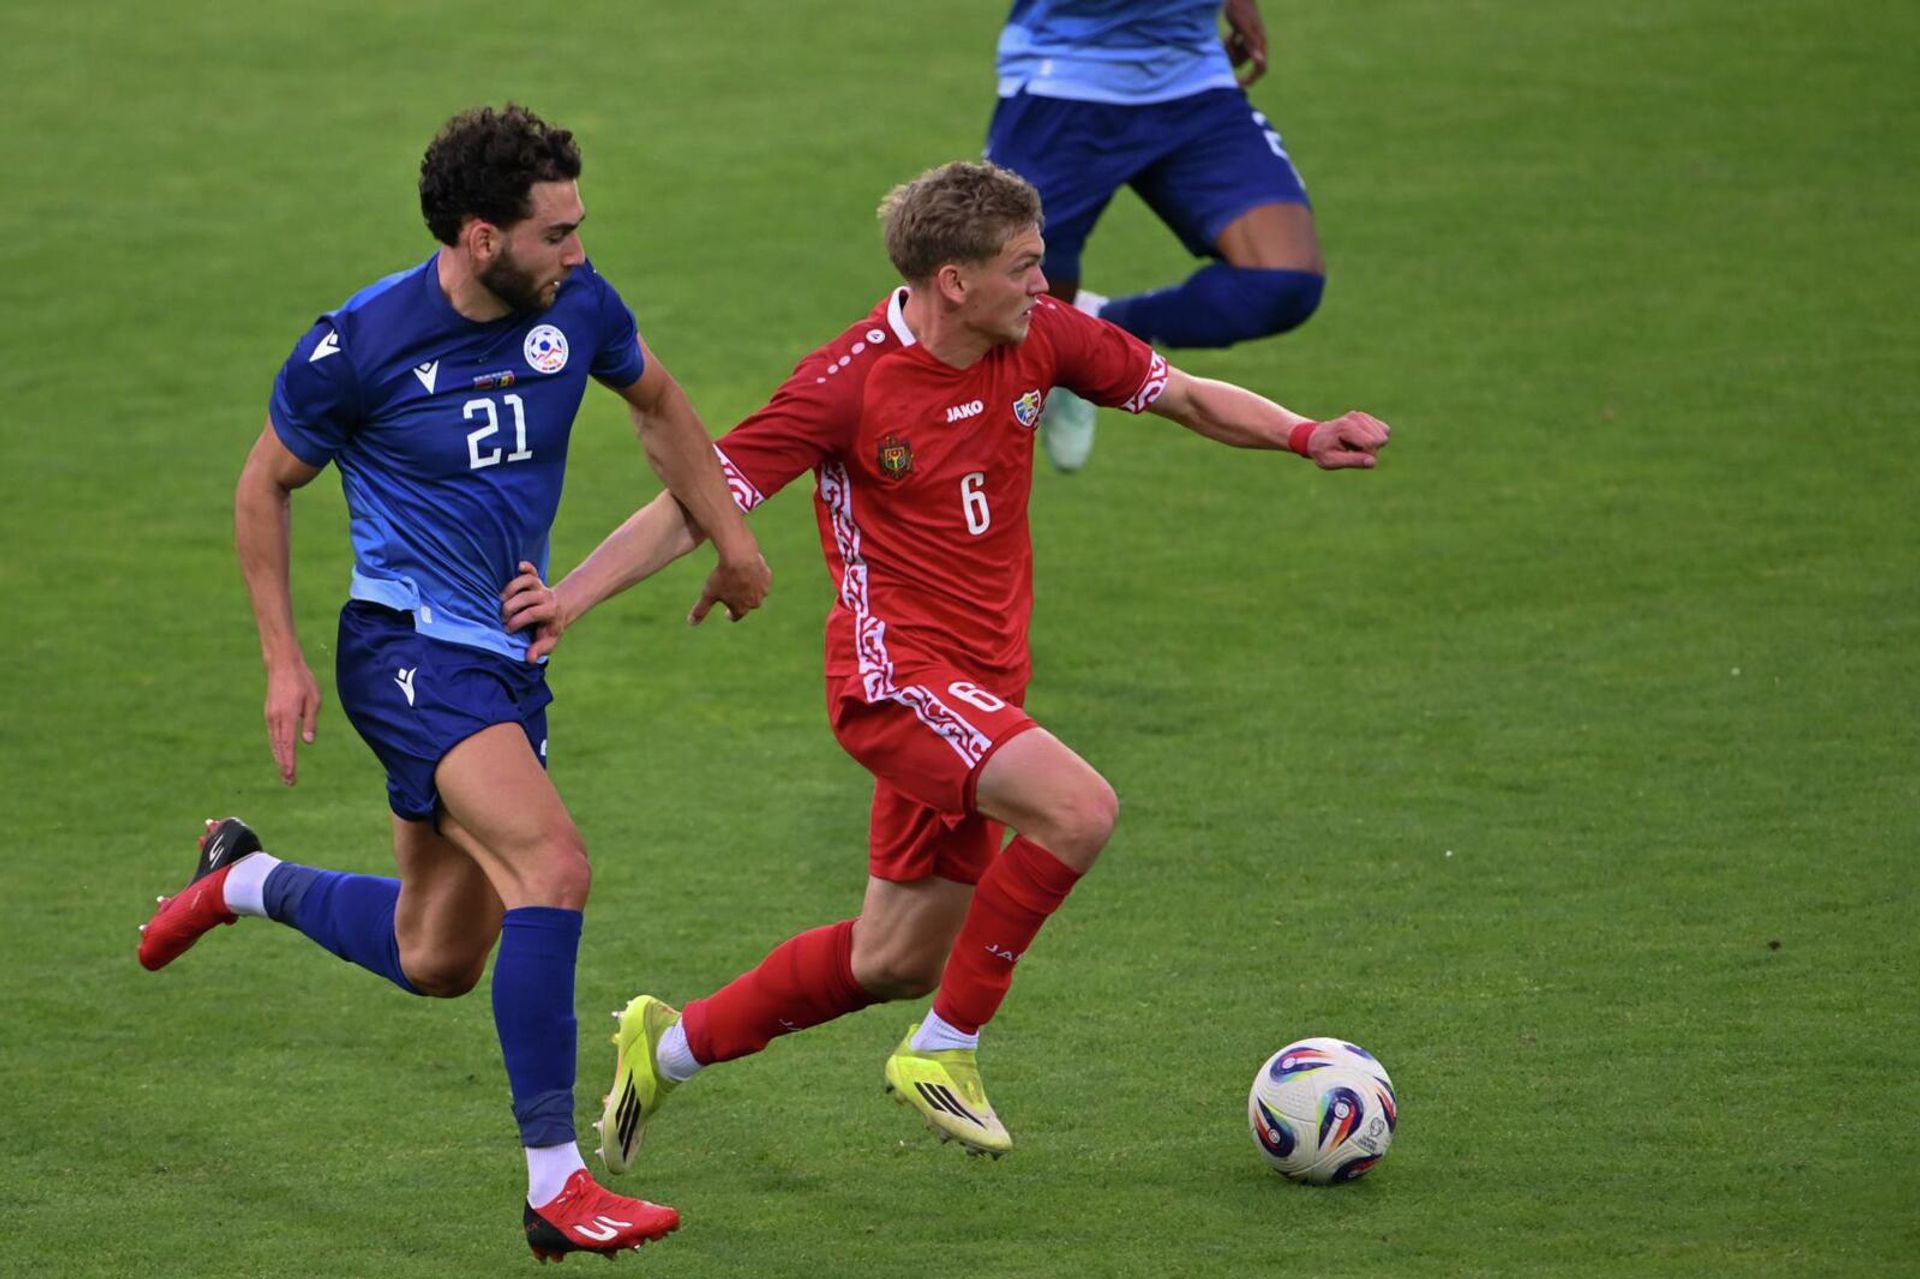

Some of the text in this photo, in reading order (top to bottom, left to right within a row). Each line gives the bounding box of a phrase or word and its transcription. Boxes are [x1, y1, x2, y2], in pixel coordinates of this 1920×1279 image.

[946, 400, 984, 423] JAKO
[463, 394, 533, 470] 21
[960, 472, 991, 535] 6
[947, 681, 1006, 712] 6
[984, 944, 1021, 962] JA
